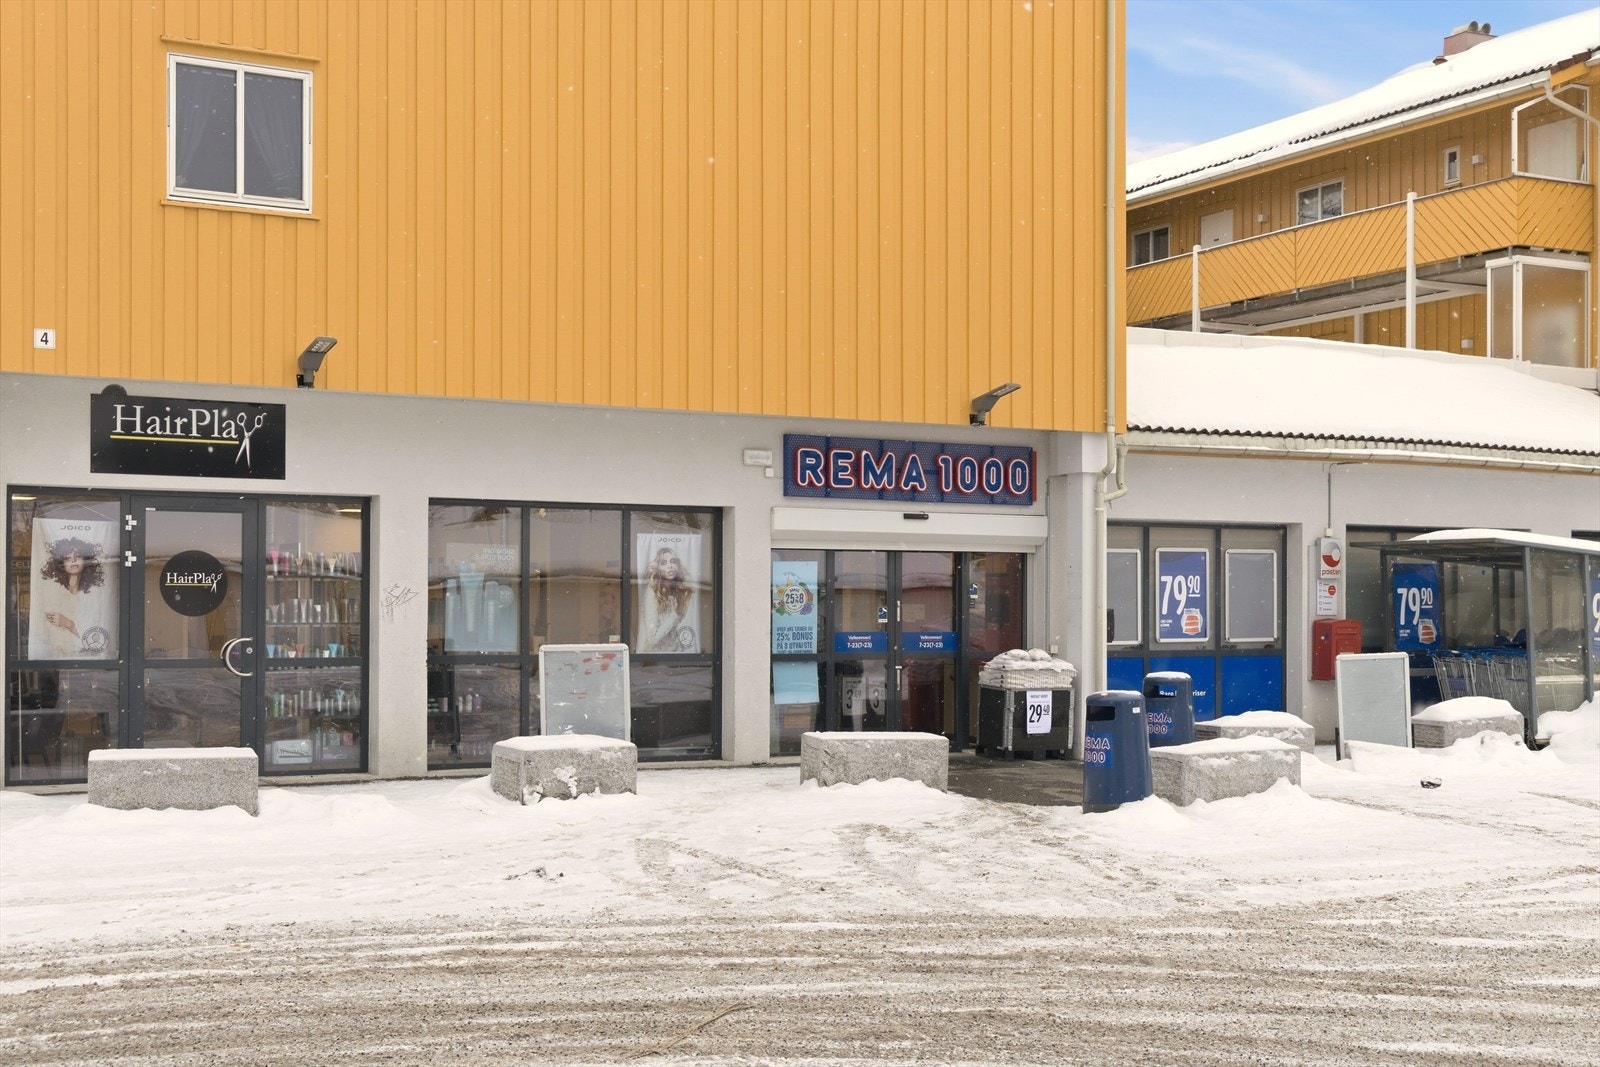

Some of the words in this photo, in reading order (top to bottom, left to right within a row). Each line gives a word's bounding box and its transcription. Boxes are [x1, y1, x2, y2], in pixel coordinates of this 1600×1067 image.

[40, 332, 49, 345] 4
[797, 447, 928, 491] REMA
[937, 454, 1030, 495] 1000
[1160, 575, 1187, 615] 79
[1187, 575, 1200, 594] 90
[1396, 588, 1420, 625] 79
[1420, 587, 1433, 605] 90
[777, 633, 790, 641] 25%
[791, 631, 813, 640] BONUS
[1029, 704, 1042, 723] 29
[1146, 712, 1172, 723] EMA
[1147, 724, 1168, 734] 000
